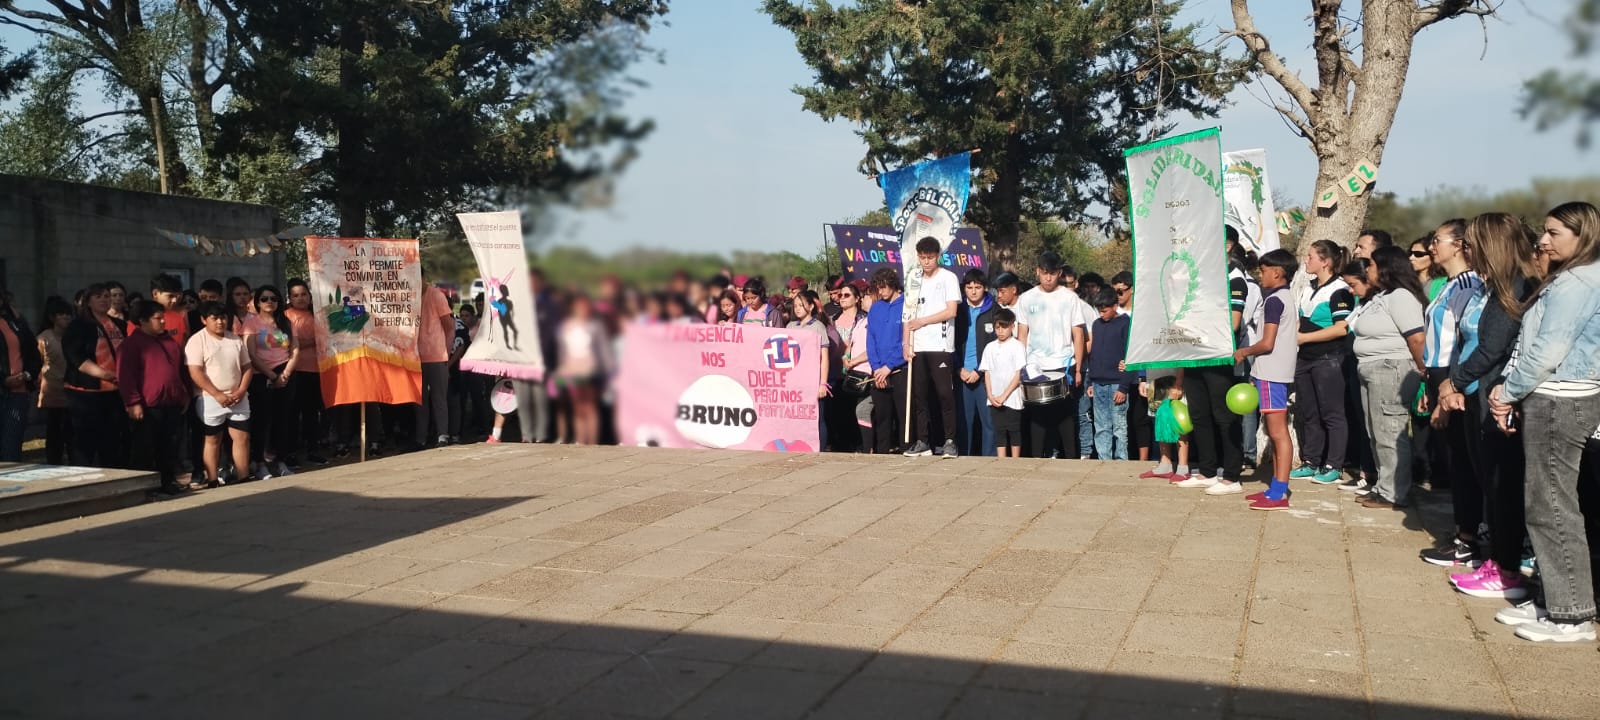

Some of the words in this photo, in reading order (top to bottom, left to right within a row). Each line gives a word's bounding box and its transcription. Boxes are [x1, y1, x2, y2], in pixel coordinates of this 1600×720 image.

[844, 247, 902, 263] VALORES
[344, 261, 360, 271] NOS
[369, 260, 403, 270] PERMITE
[345, 271, 383, 281] CONVIVIR
[387, 271, 399, 280] EN
[370, 292, 397, 303] PESAR
[400, 292, 411, 302] DE
[370, 304, 411, 314] NUESTRAS
[701, 352, 726, 368] NOS
[748, 370, 787, 388] DUELE
[754, 389, 779, 403] PERO
[780, 390, 803, 403] NOS
[676, 404, 757, 427] BRUNO
